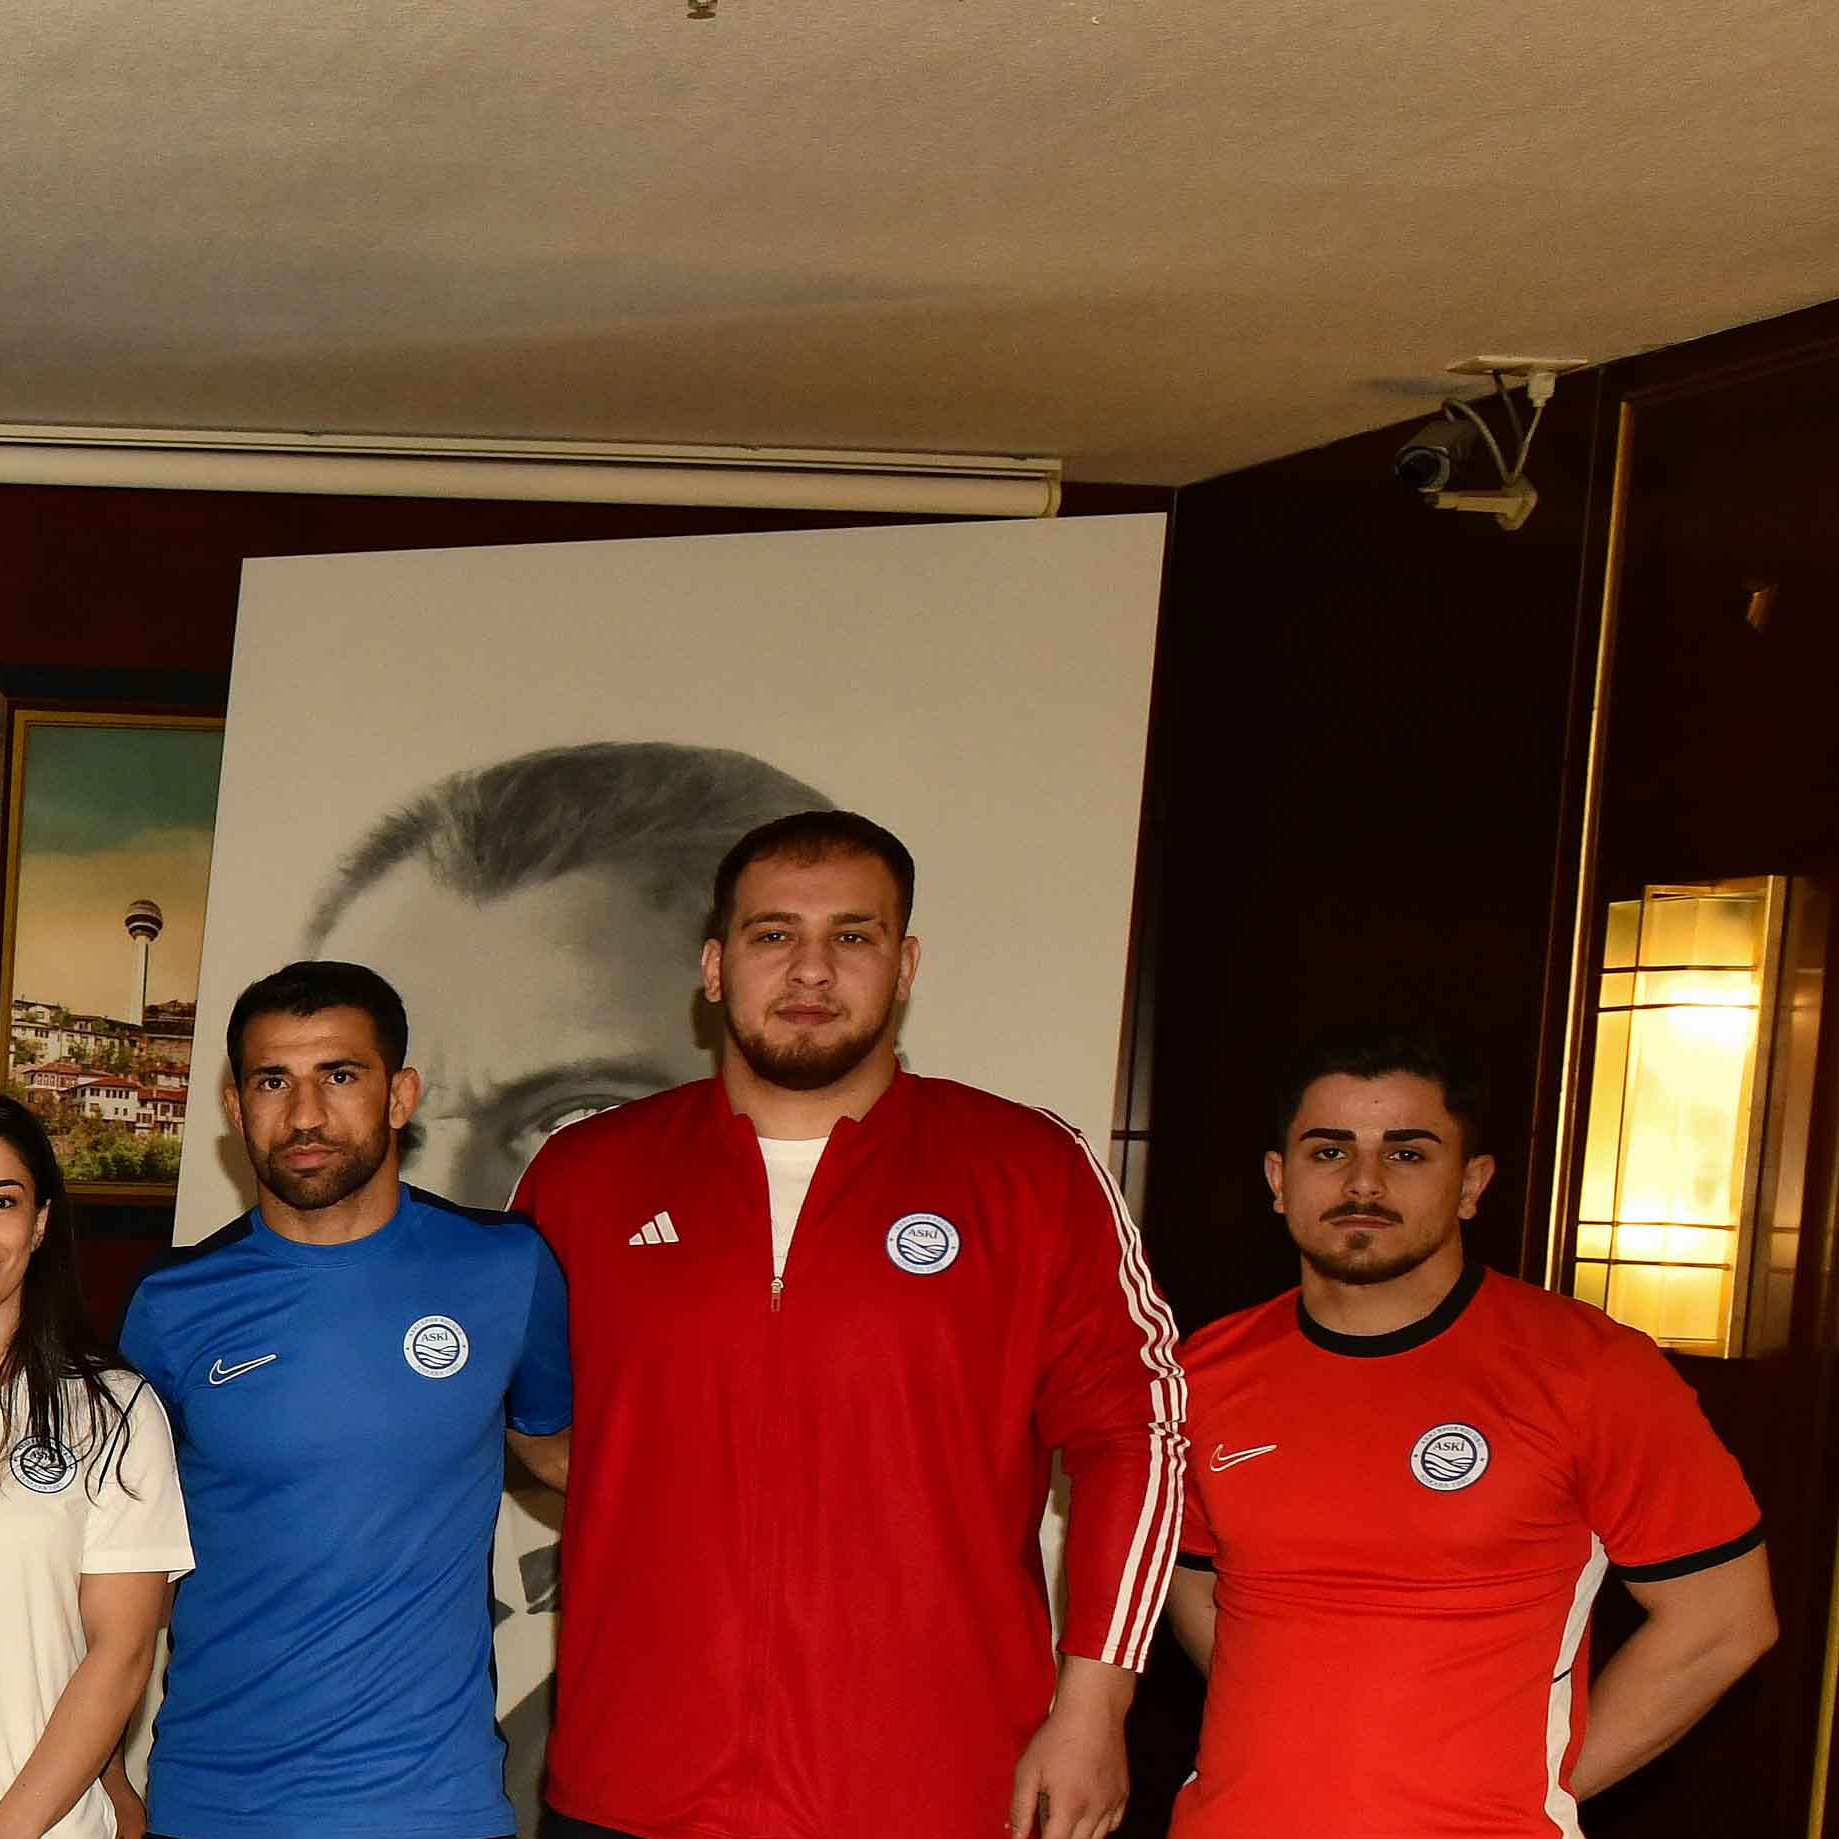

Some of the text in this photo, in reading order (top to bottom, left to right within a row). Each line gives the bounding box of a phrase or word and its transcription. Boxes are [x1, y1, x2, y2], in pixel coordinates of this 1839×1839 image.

[908, 1228, 939, 1240] ASKİ
[421, 1330, 449, 1342] ASKİ
[1432, 1439, 1465, 1452] ASKİ
